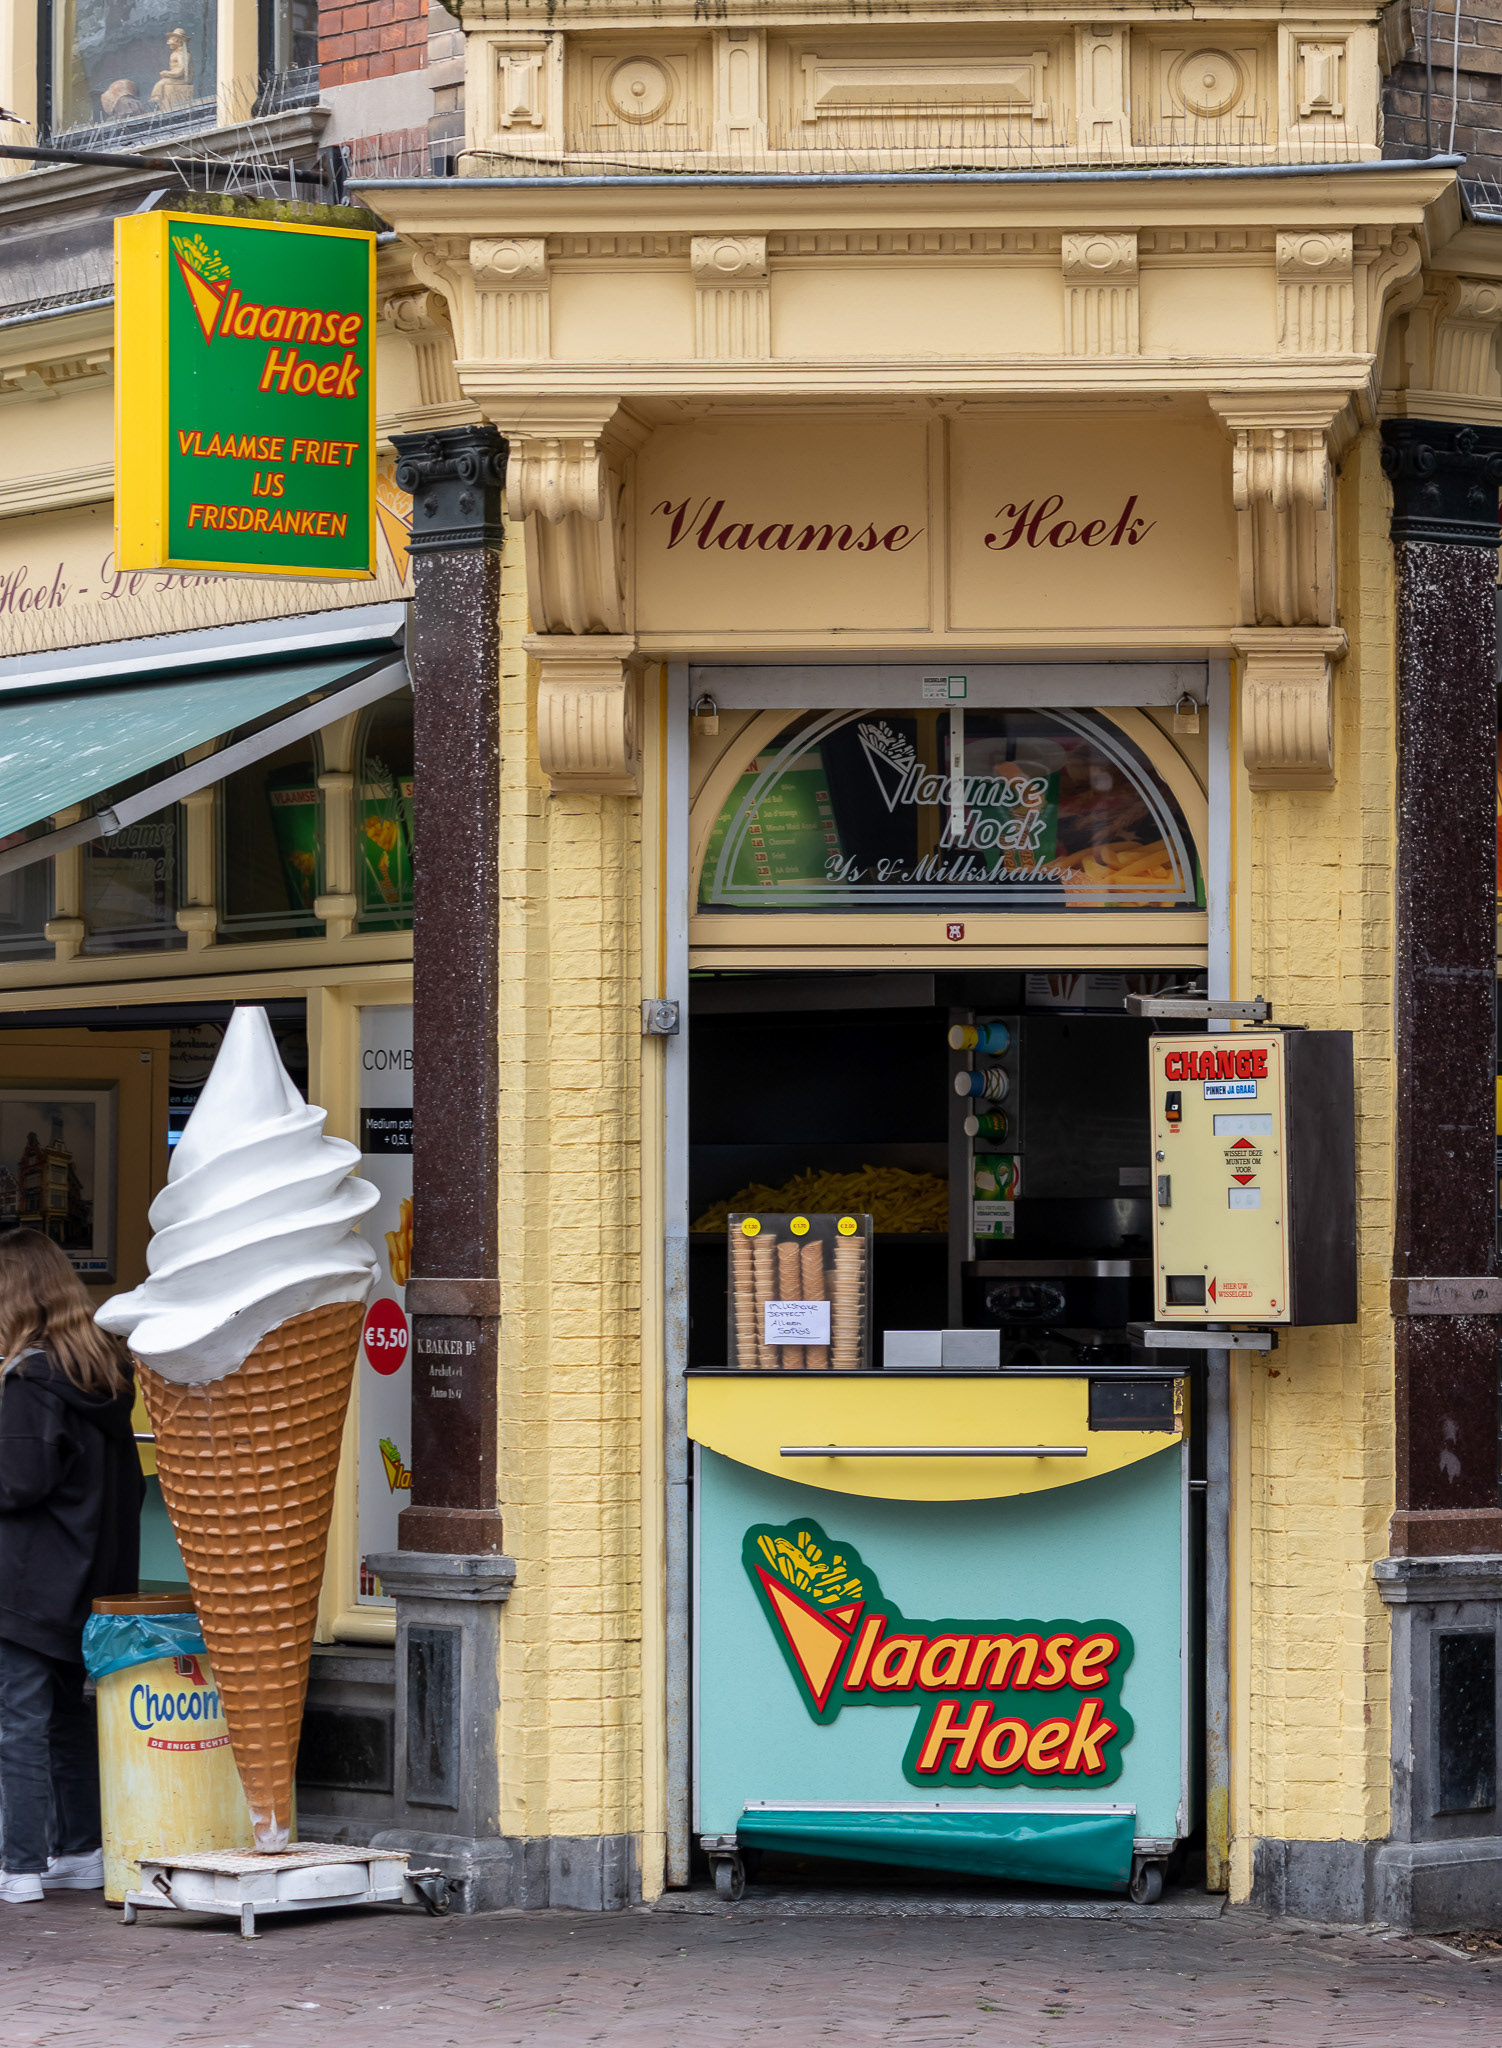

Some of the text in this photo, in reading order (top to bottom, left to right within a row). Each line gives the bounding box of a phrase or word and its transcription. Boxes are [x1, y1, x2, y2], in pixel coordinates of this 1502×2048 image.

[258, 346, 364, 400] Hoek
[178, 429, 360, 468] VLAAMSE FRIET
[251, 471, 286, 498] IJS
[186, 503, 349, 539] FRISDRANKEN
[650, 494, 1158, 551] Vlaamse Hoek
[275, 791, 315, 804] VLAAMSE
[940, 809, 1048, 852] Hoek
[877, 857, 903, 884] &
[902, 854, 1081, 884] Milkshakes
[363, 1049, 414, 1071] COMB
[1164, 1049, 1269, 1081] CHANGE
[1205, 1084, 1255, 1097] PINNEN JA GRAAG
[366, 1118, 398, 1129] Medium
[1218, 1290, 1253, 1298] WISSELGELD
[1222, 1282, 1248, 1290] HIER UW
[365, 1326, 408, 1350] €5,50
[151, 1740, 163, 1748] DE
[915, 1697, 1118, 1776] Hoek
